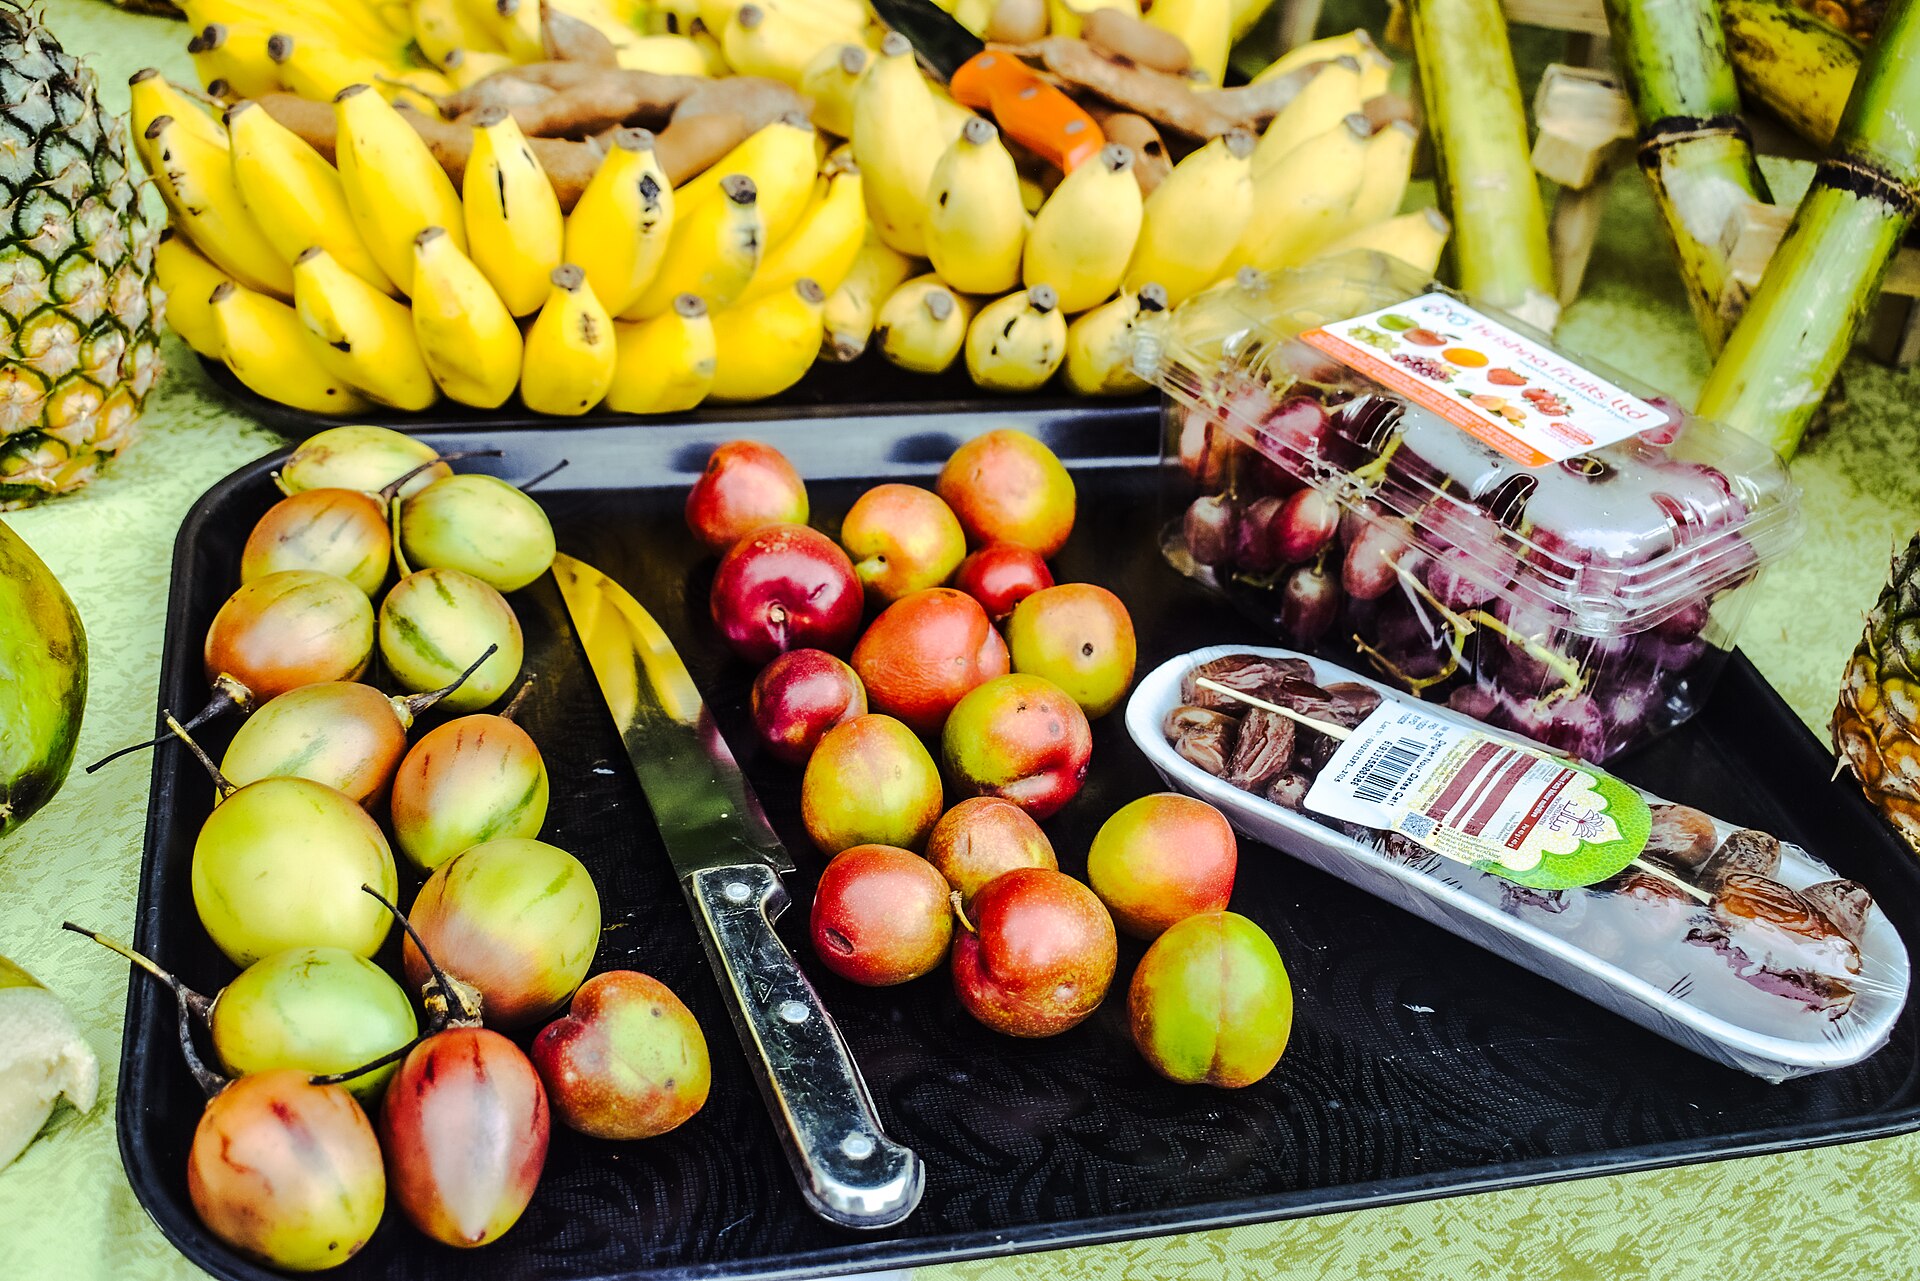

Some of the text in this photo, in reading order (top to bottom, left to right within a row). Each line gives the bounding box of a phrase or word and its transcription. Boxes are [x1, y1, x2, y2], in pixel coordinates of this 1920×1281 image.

[1428, 740, 1446, 758] Deglet
[1416, 757, 1431, 773] Nour
[1399, 772, 1419, 791] Dates
